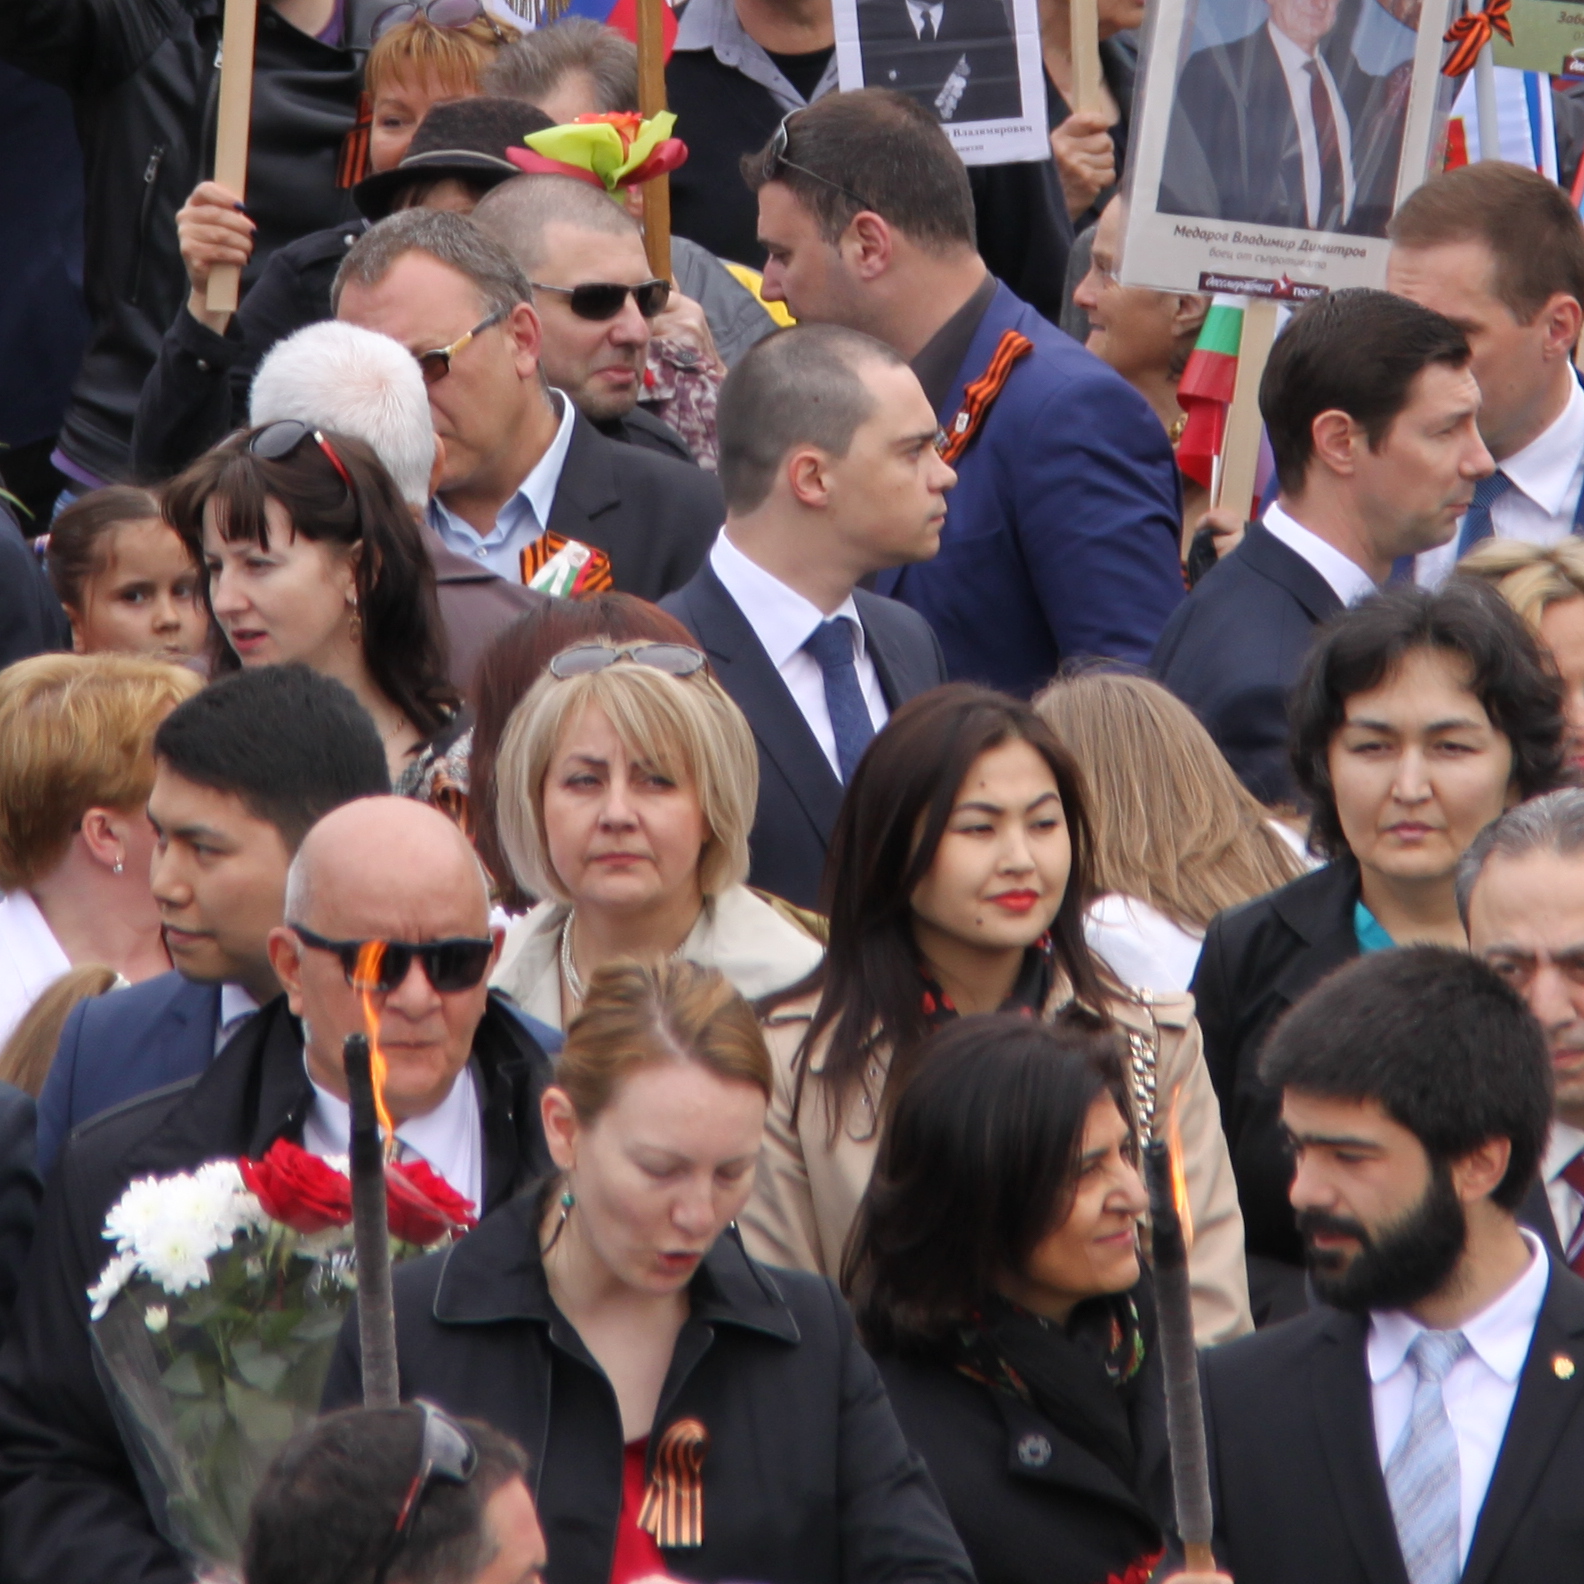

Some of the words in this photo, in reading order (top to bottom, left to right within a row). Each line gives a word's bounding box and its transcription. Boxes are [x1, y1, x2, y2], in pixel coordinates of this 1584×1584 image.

[1173, 224, 1229, 243] Медаров
[1232, 231, 1296, 250] Владимир
[1299, 240, 1367, 258] Димитров
[1208, 247, 1233, 260] боец
[1236, 252, 1253, 261] от
